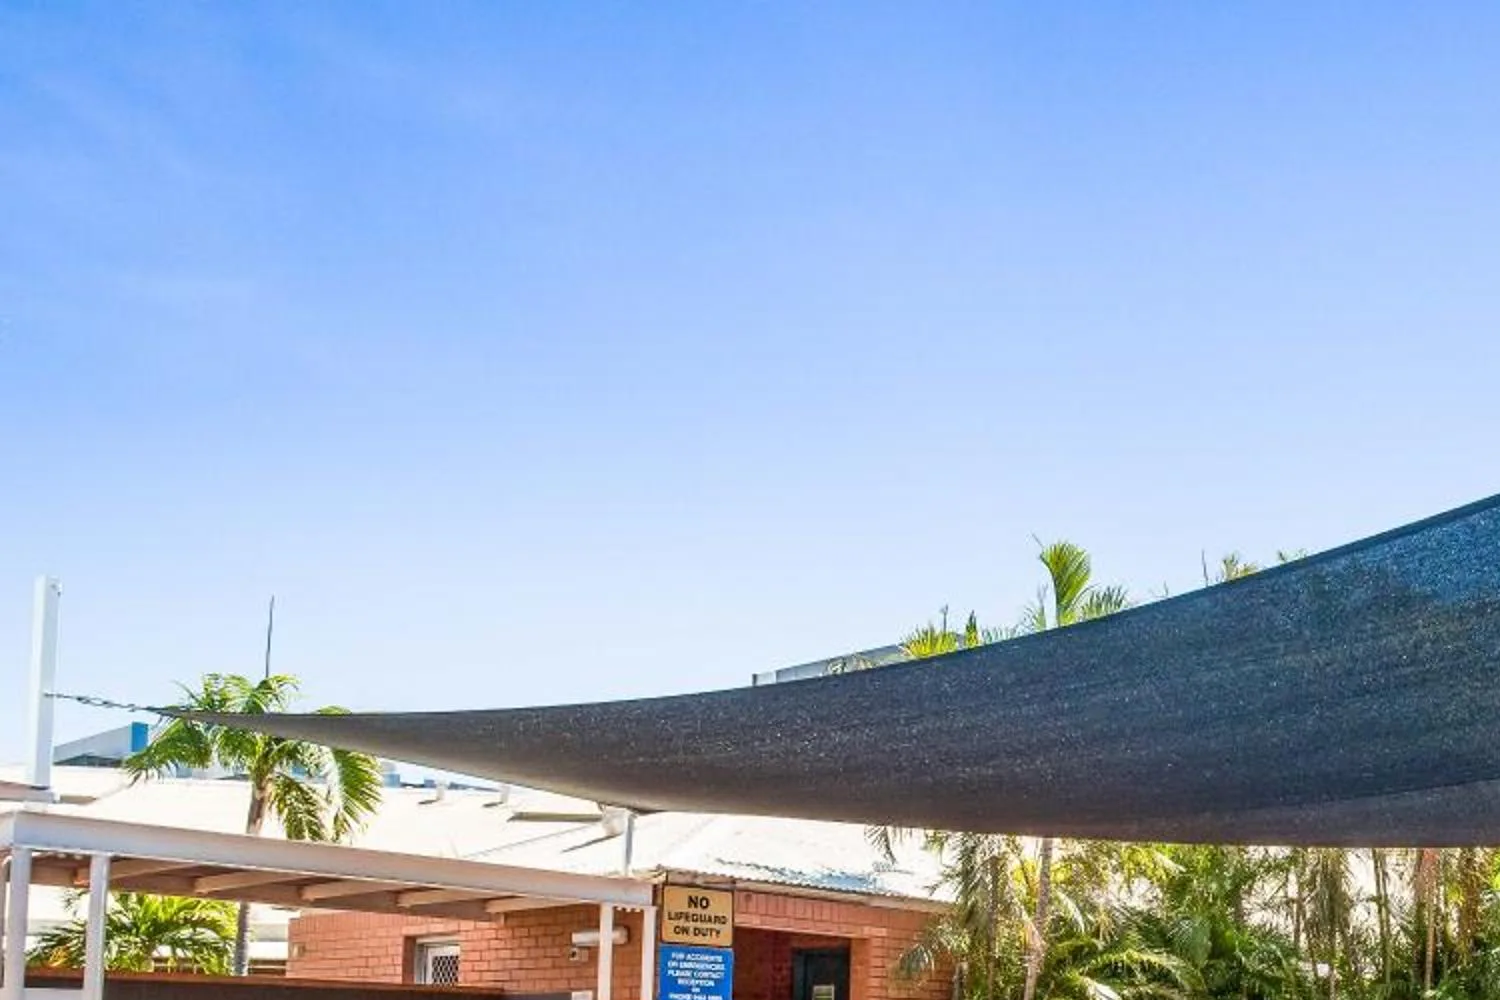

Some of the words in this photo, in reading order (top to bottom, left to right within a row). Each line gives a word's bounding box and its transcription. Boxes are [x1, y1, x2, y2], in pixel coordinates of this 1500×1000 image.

[687, 895, 709, 909] NO
[667, 911, 727, 925] LIFEGUARD
[673, 925, 689, 936] ON
[693, 927, 721, 938] DUTY
